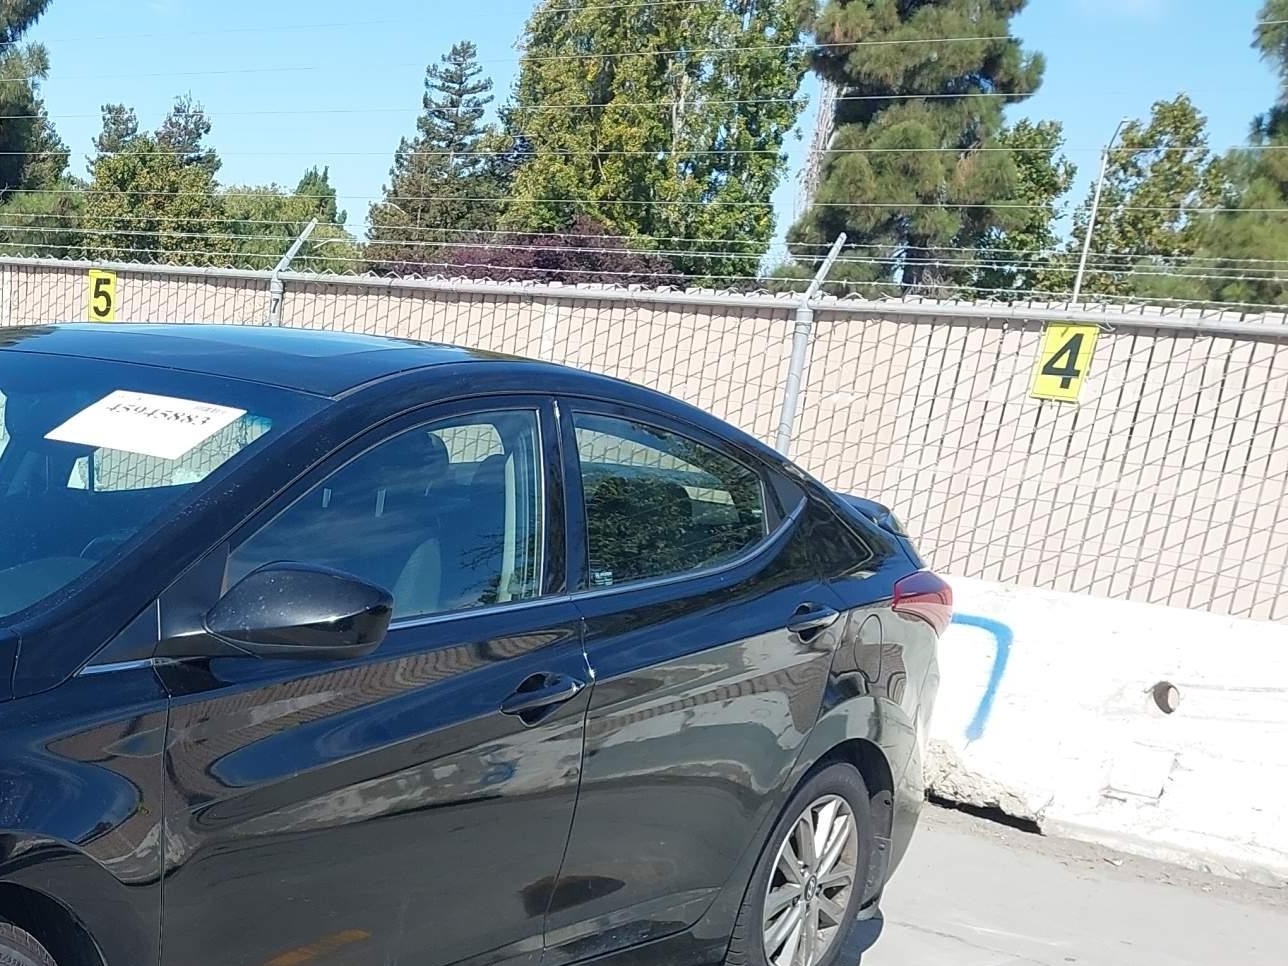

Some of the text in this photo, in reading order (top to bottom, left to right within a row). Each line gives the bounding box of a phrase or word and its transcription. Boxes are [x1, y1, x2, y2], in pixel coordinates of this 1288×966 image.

[93, 277, 112, 317] 5
[1041, 333, 1085, 389] 4
[106, 402, 211, 425] 45945883
